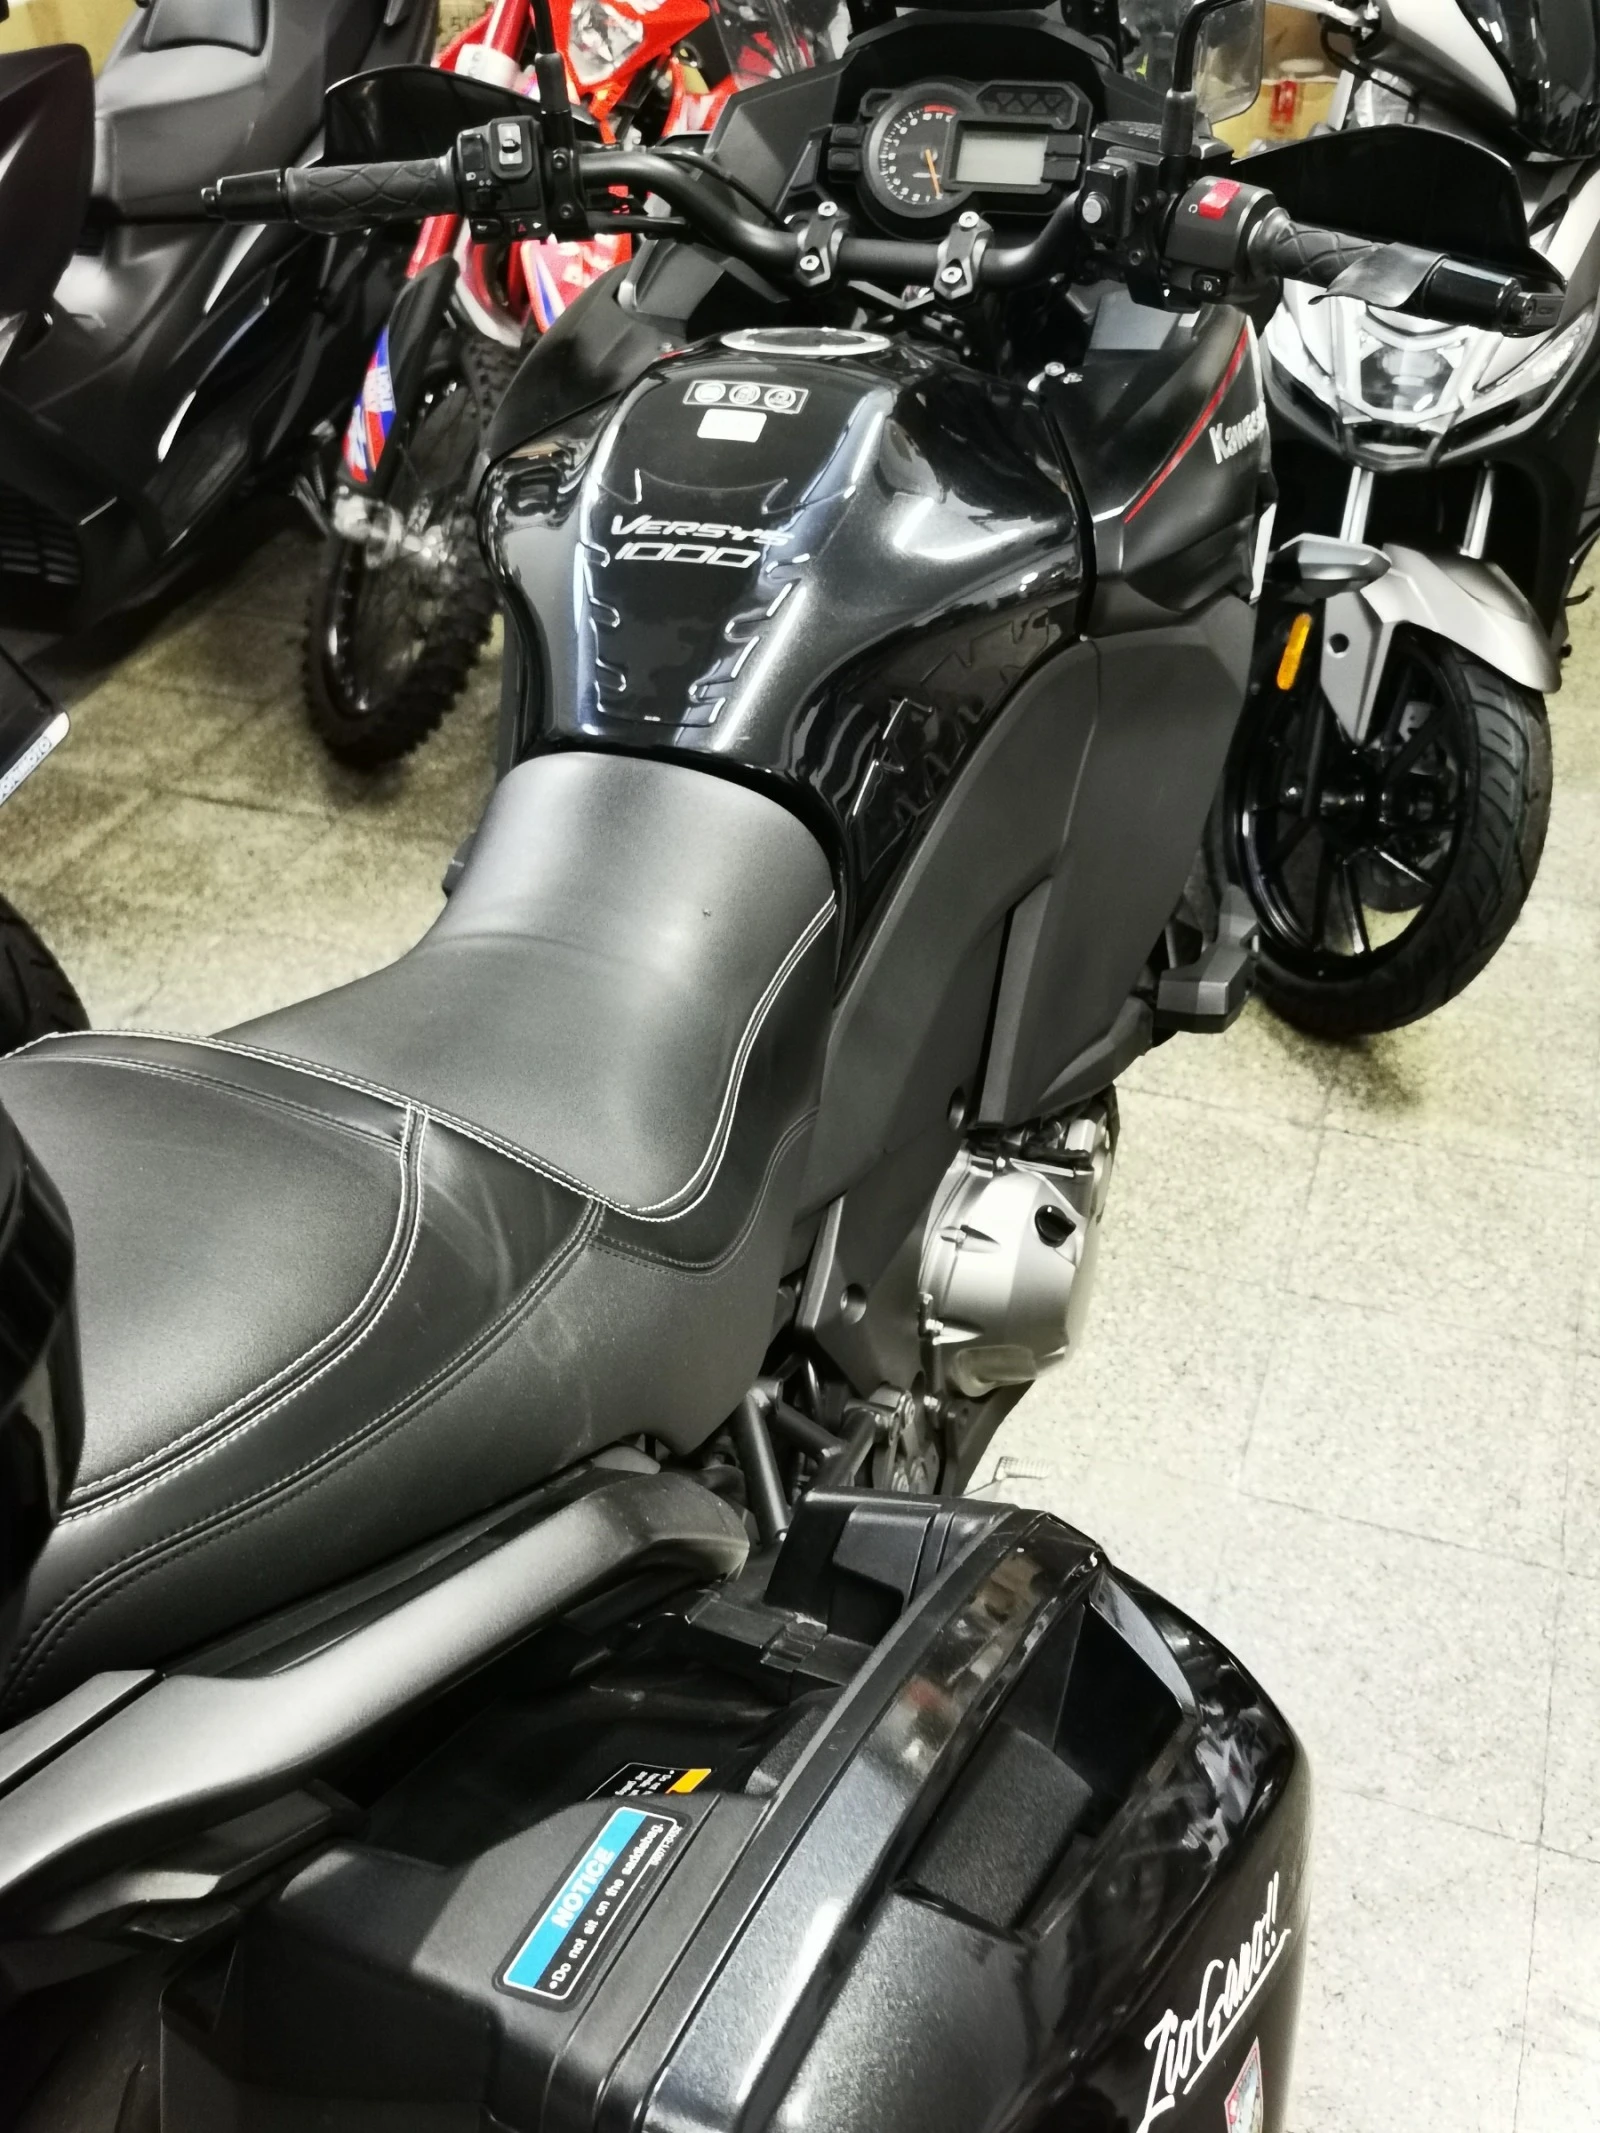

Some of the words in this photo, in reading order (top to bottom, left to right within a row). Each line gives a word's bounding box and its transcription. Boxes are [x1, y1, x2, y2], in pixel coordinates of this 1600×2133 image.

[611, 514, 794, 547] VERSYS
[615, 542, 761, 568] 1000
[551, 1846, 616, 1929] NOTICE
[570, 1938, 587, 1959] not
[584, 1920, 600, 1936] sit
[596, 1900, 611, 1917] on
[606, 1878, 625, 1898] the
[621, 1823, 664, 1875] saddlebag.
